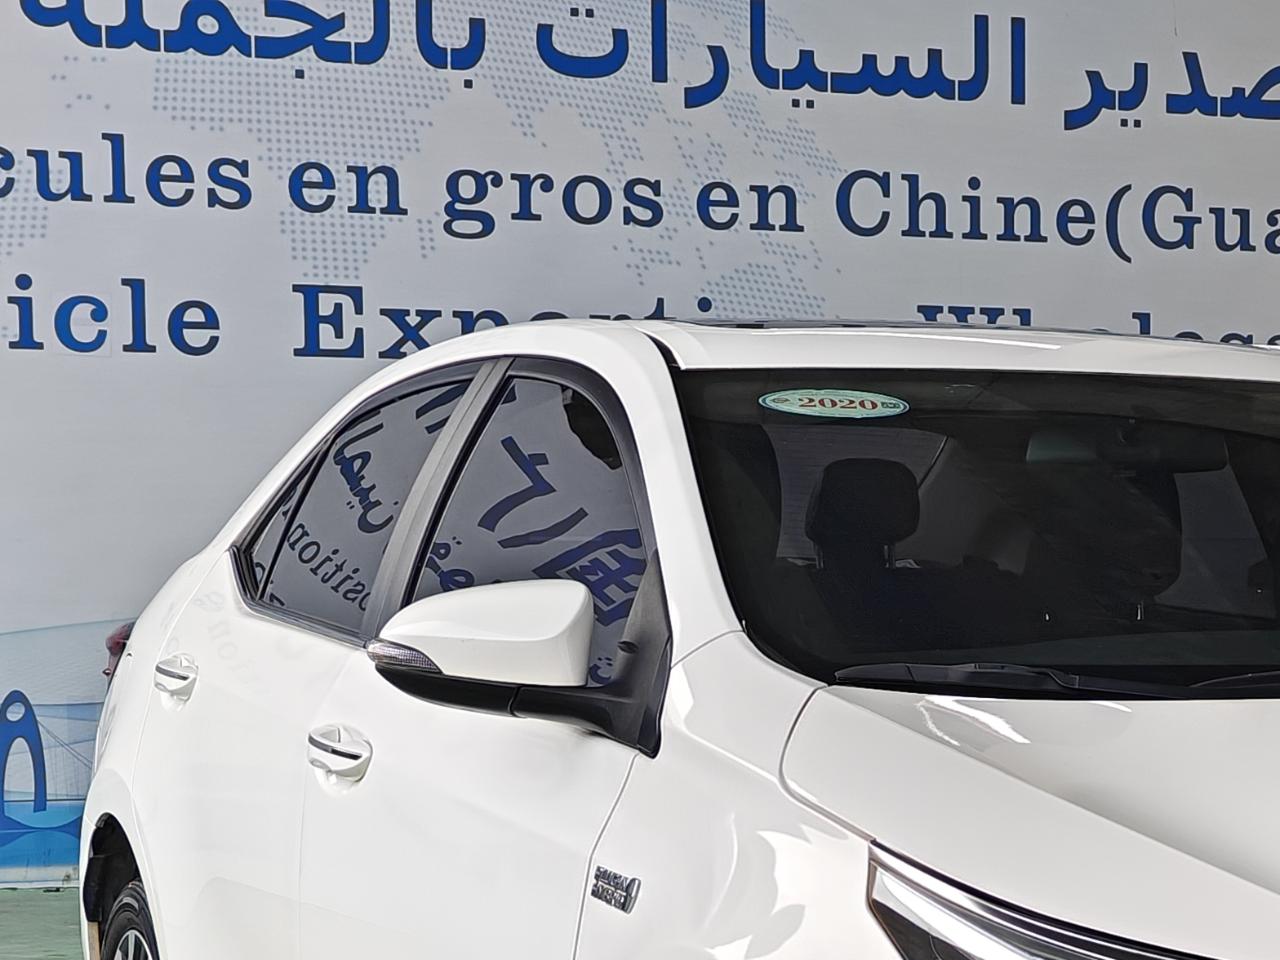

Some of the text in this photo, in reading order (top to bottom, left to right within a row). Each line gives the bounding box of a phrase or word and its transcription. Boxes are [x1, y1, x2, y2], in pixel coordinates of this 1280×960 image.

[536, 0, 1026, 115] السيارات
[288, 161, 408, 216] en
[443, 169, 665, 239] gros
[696, 181, 805, 233] en
[7, 273, 221, 357] icle
[797, 396, 878, 411] 2020
